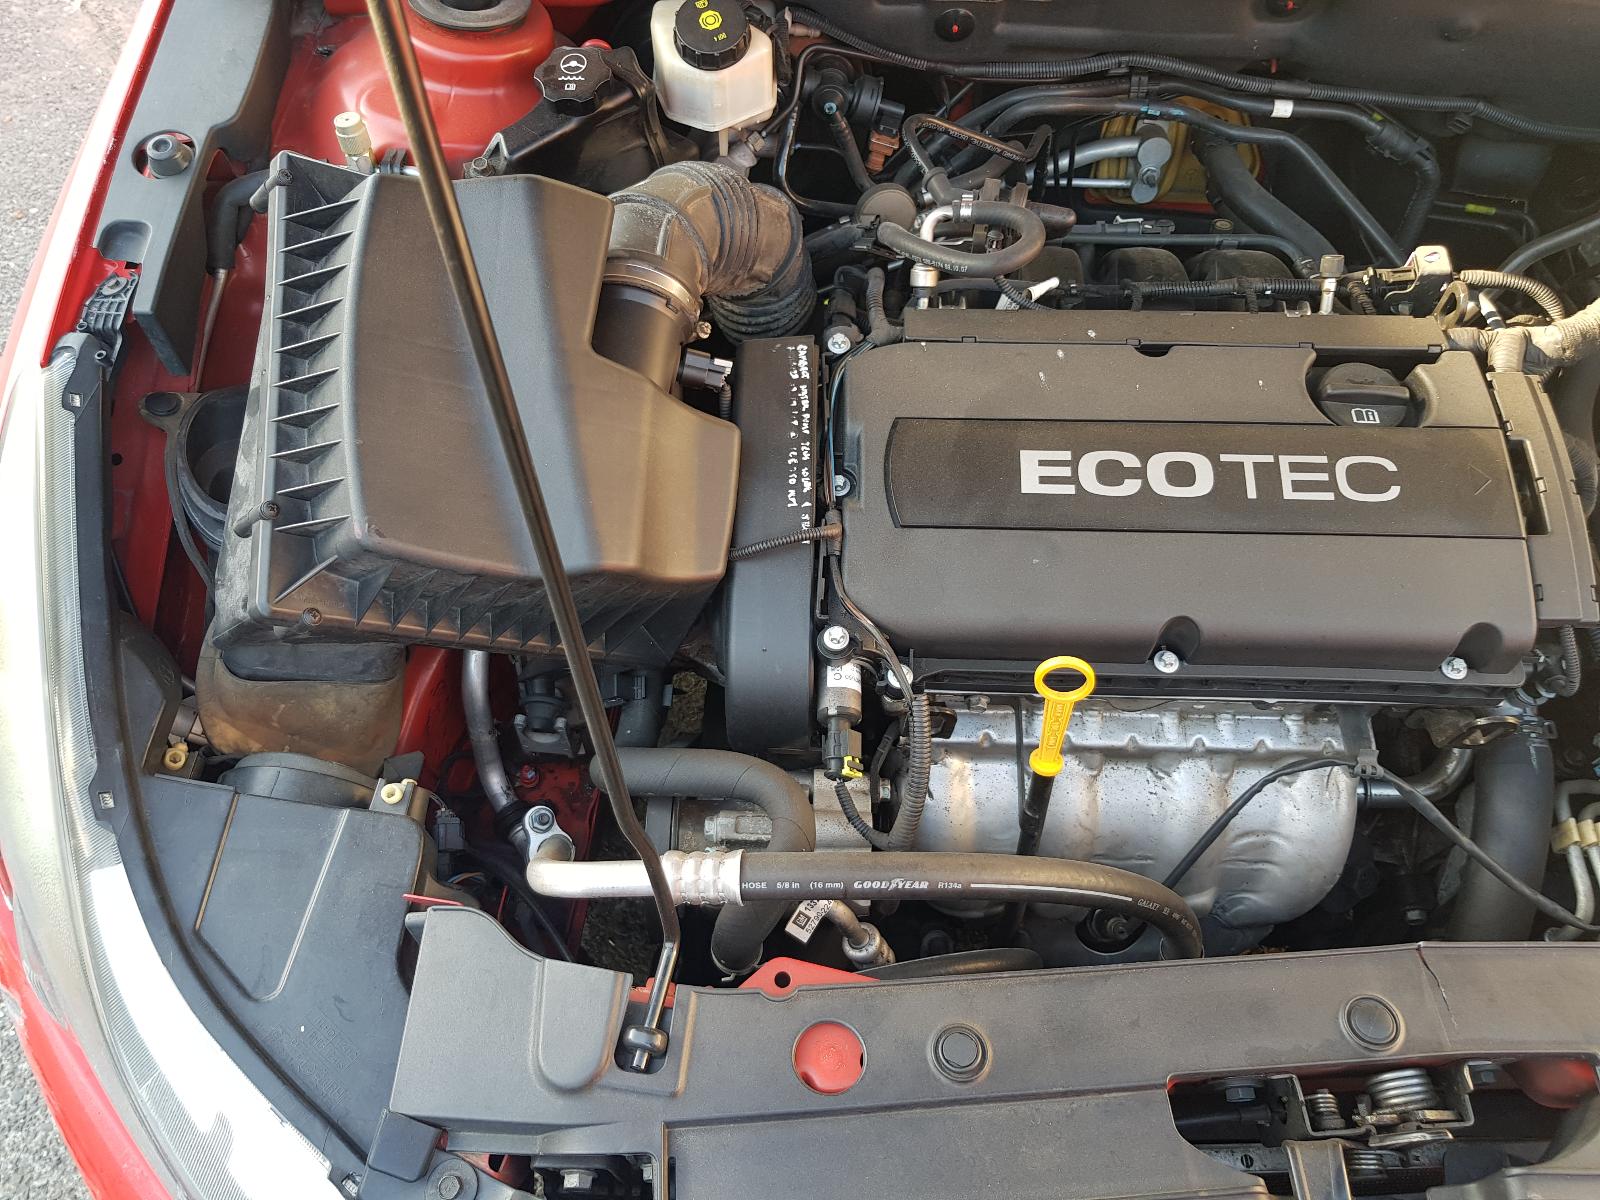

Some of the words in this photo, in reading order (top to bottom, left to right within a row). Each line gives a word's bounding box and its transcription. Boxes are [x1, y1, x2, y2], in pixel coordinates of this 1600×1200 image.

[1019, 449, 1401, 503] ECOTEC
[742, 881, 768, 889] HOSE
[809, 881, 823, 890] (16
[825, 881, 844, 890] mm)
[853, 878, 929, 891] GOODYEAR
[937, 881, 962, 889] R134a
